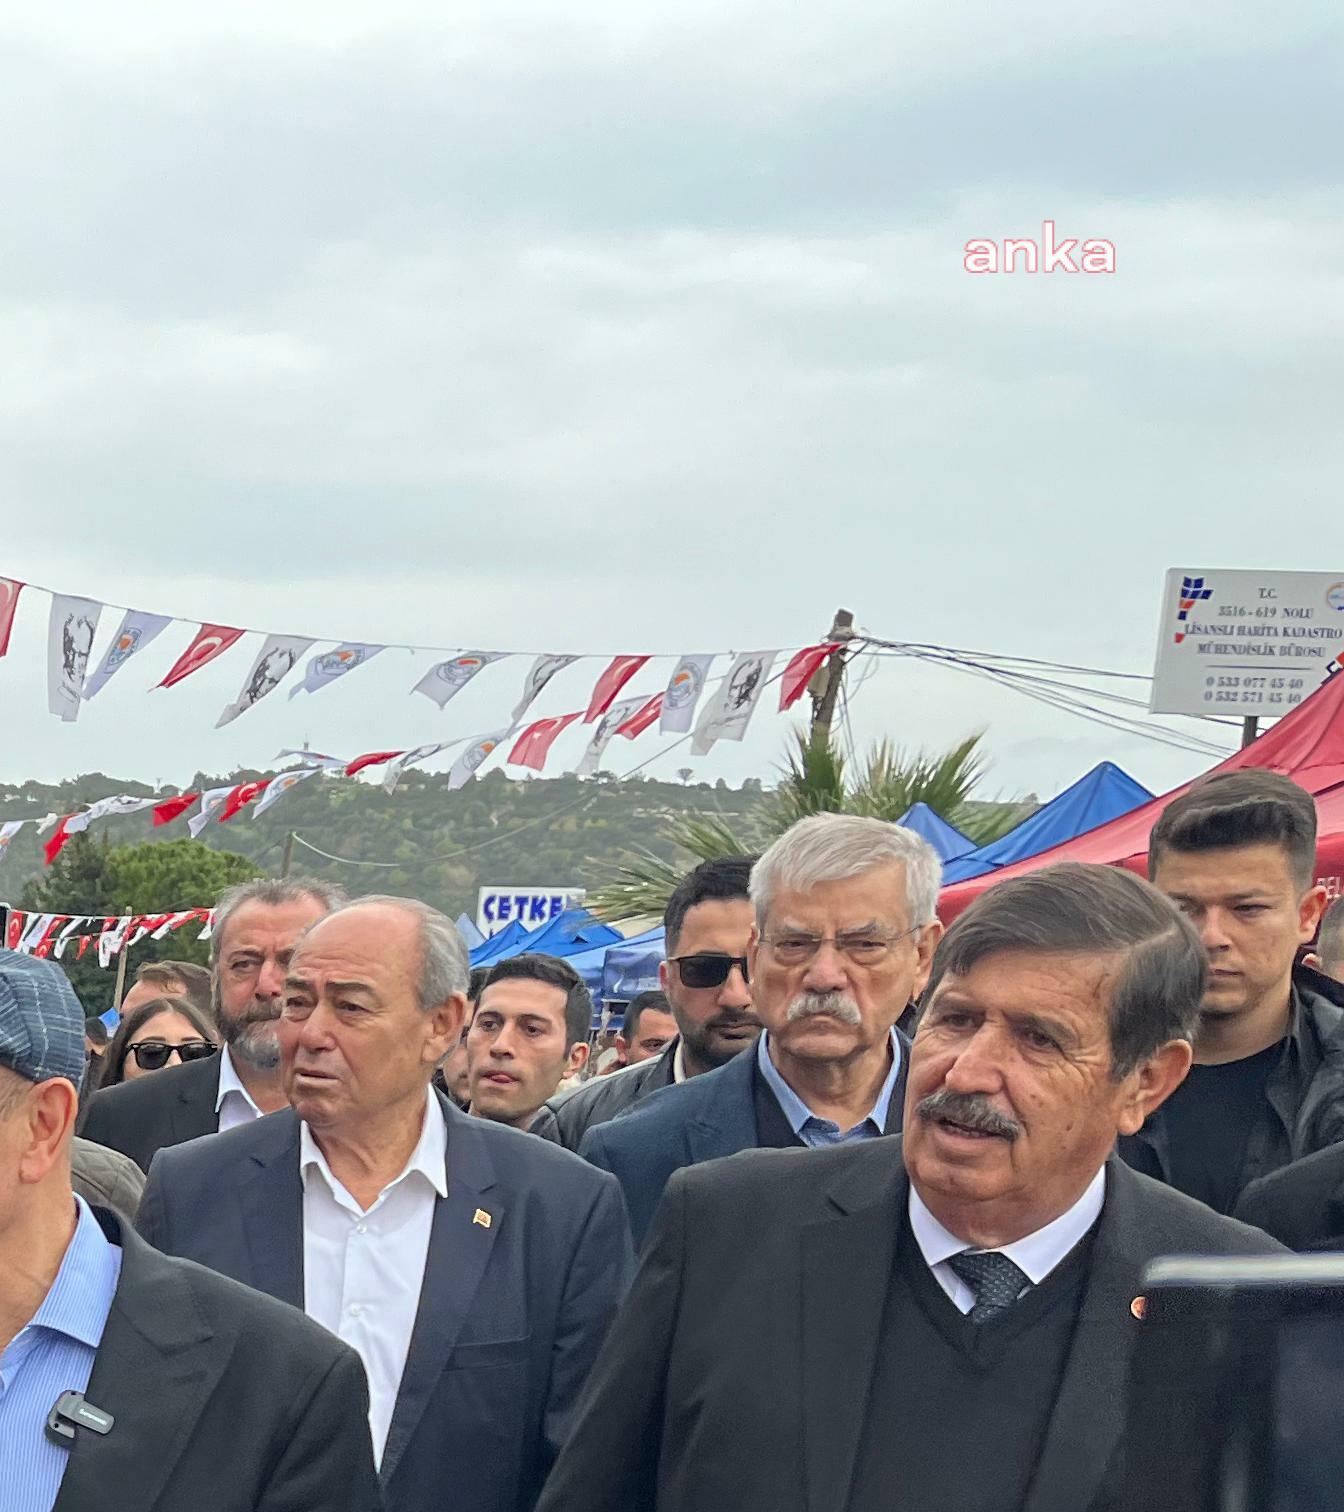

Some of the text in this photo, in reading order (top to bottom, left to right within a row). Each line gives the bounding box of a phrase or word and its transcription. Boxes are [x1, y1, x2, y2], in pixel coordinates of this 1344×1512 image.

[1282, 607, 1314, 619] NOLU
[1237, 624, 1279, 637] HARİTA
[1283, 626, 1343, 639] KADASTRO
[1198, 641, 1326, 658] MÜHENDİSLİK BÜROSU
[1206, 676, 1215, 687] 0
